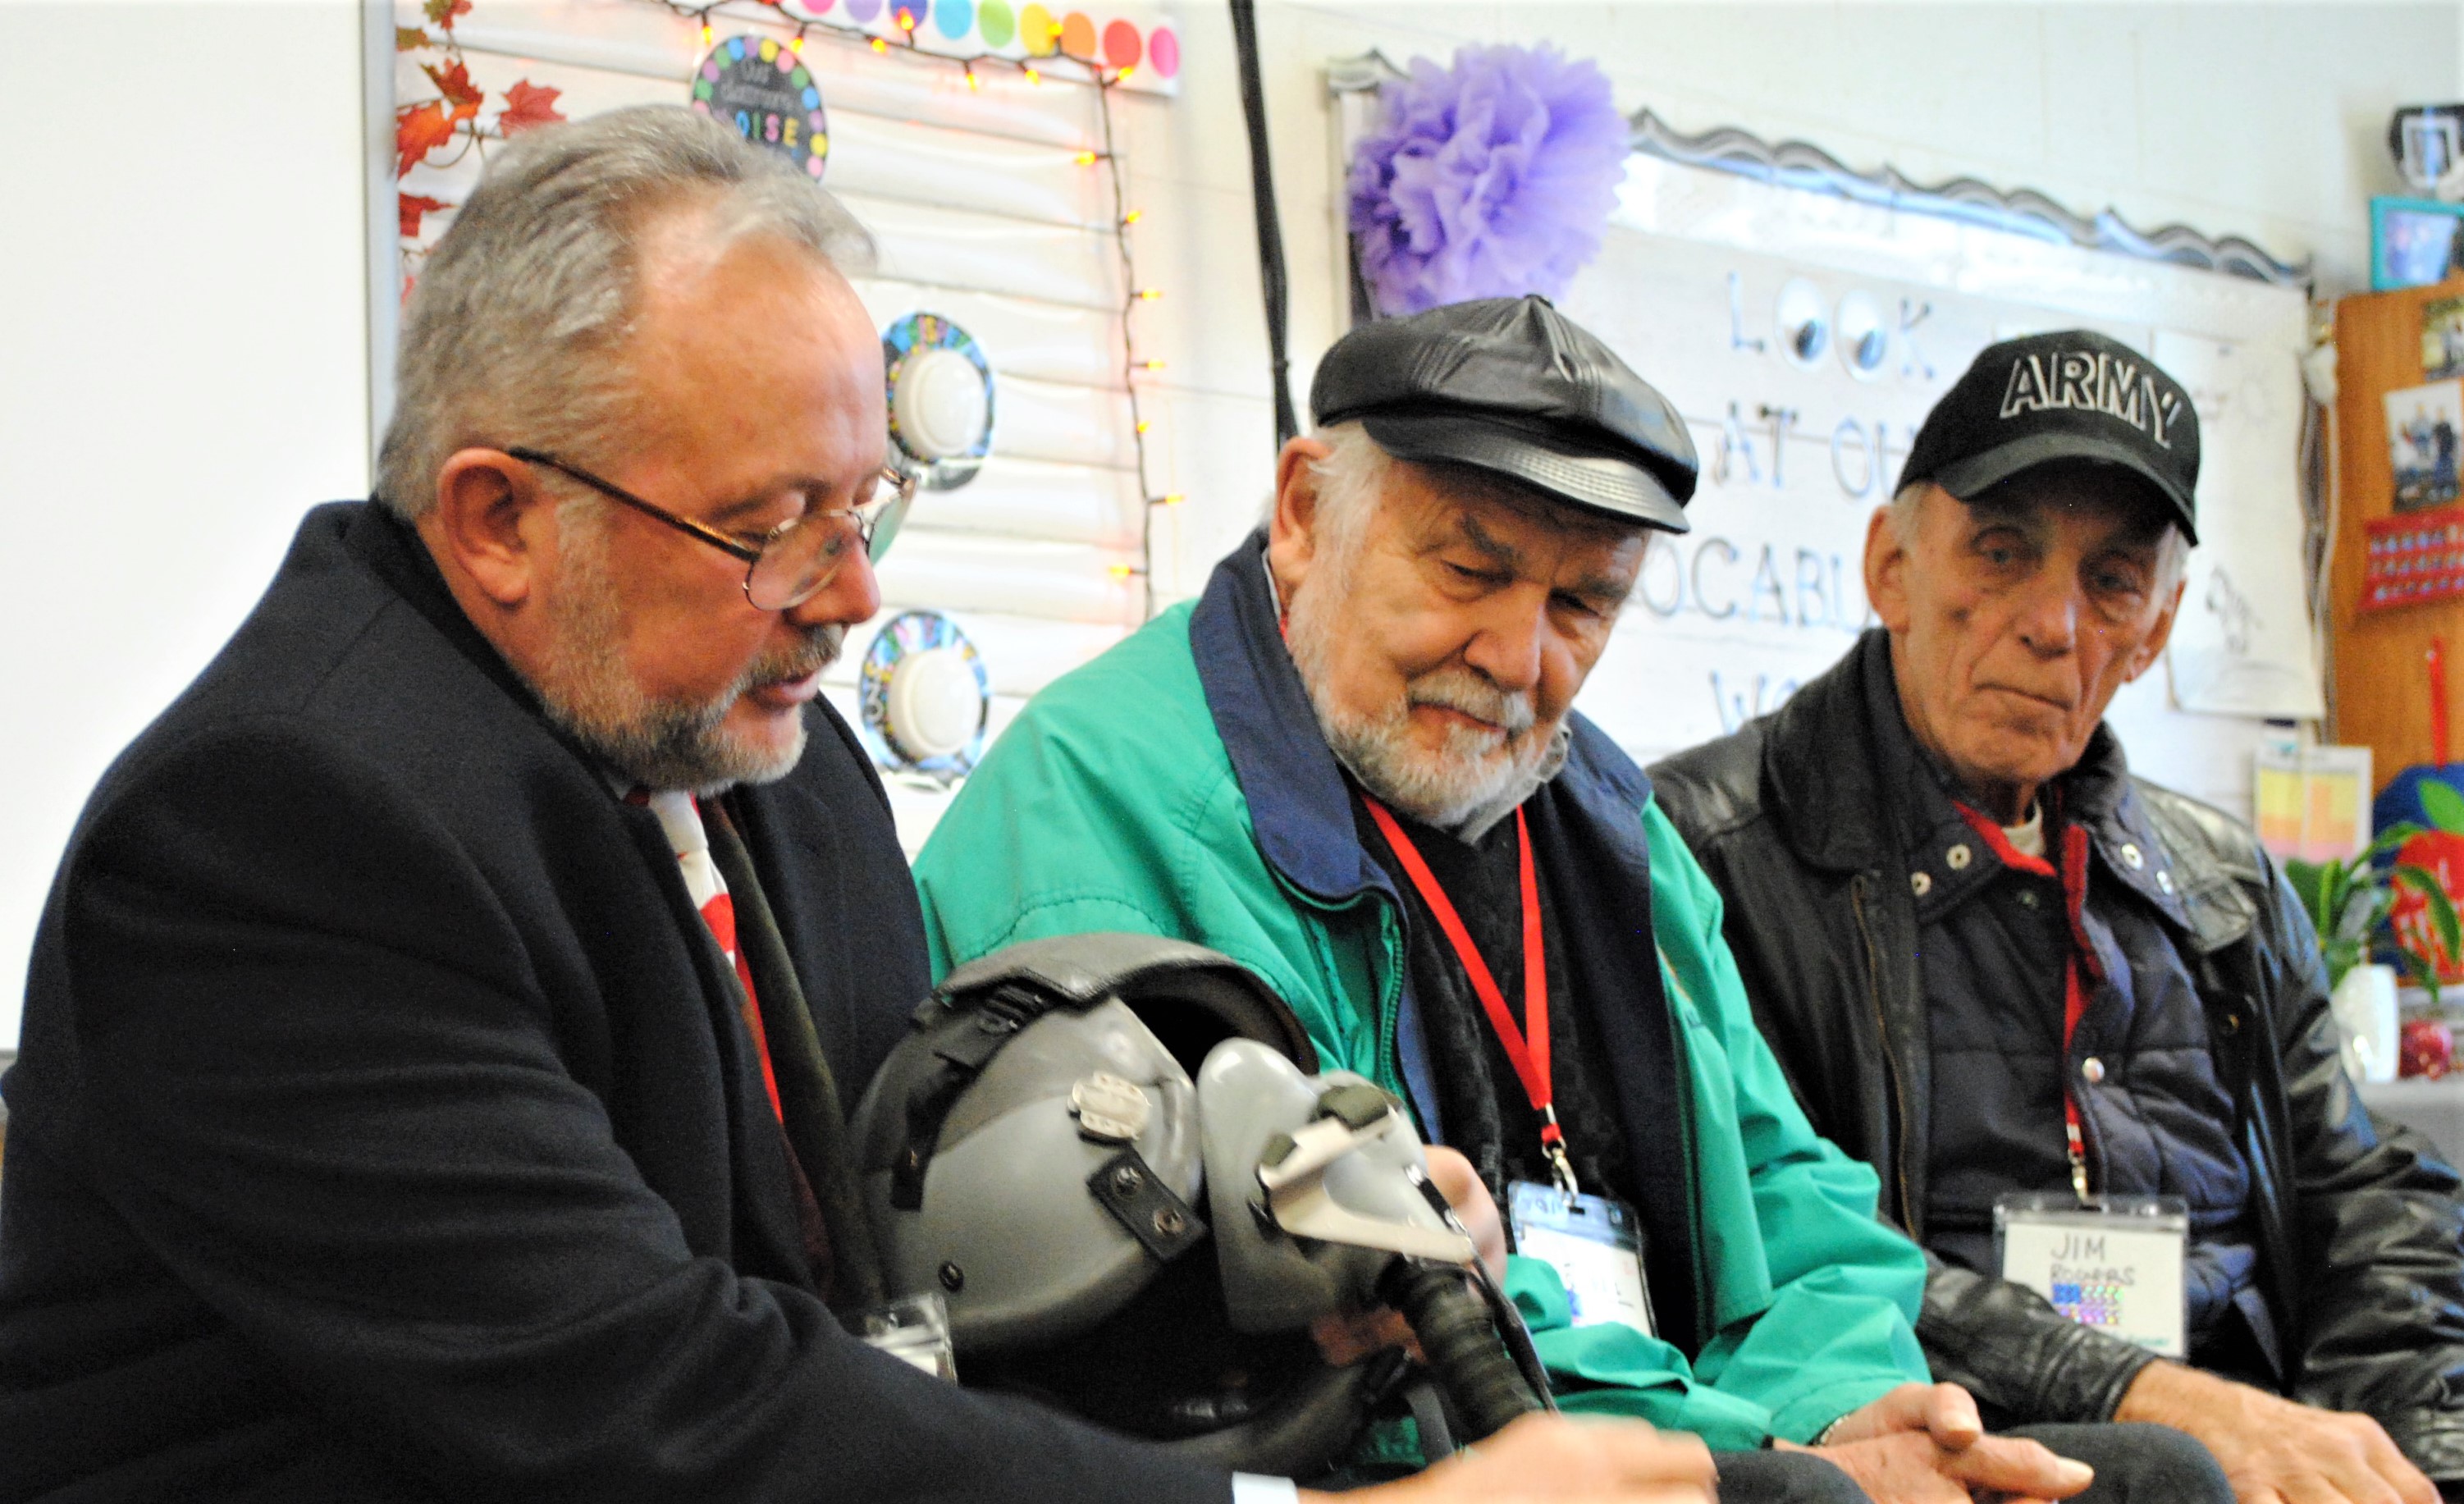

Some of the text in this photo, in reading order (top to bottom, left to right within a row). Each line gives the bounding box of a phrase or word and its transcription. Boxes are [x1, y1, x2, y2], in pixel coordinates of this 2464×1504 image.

[1999, 350, 2183, 450] ARMY
[1714, 399, 1918, 503] AT OU
[2050, 1232, 2105, 1261] JIM
